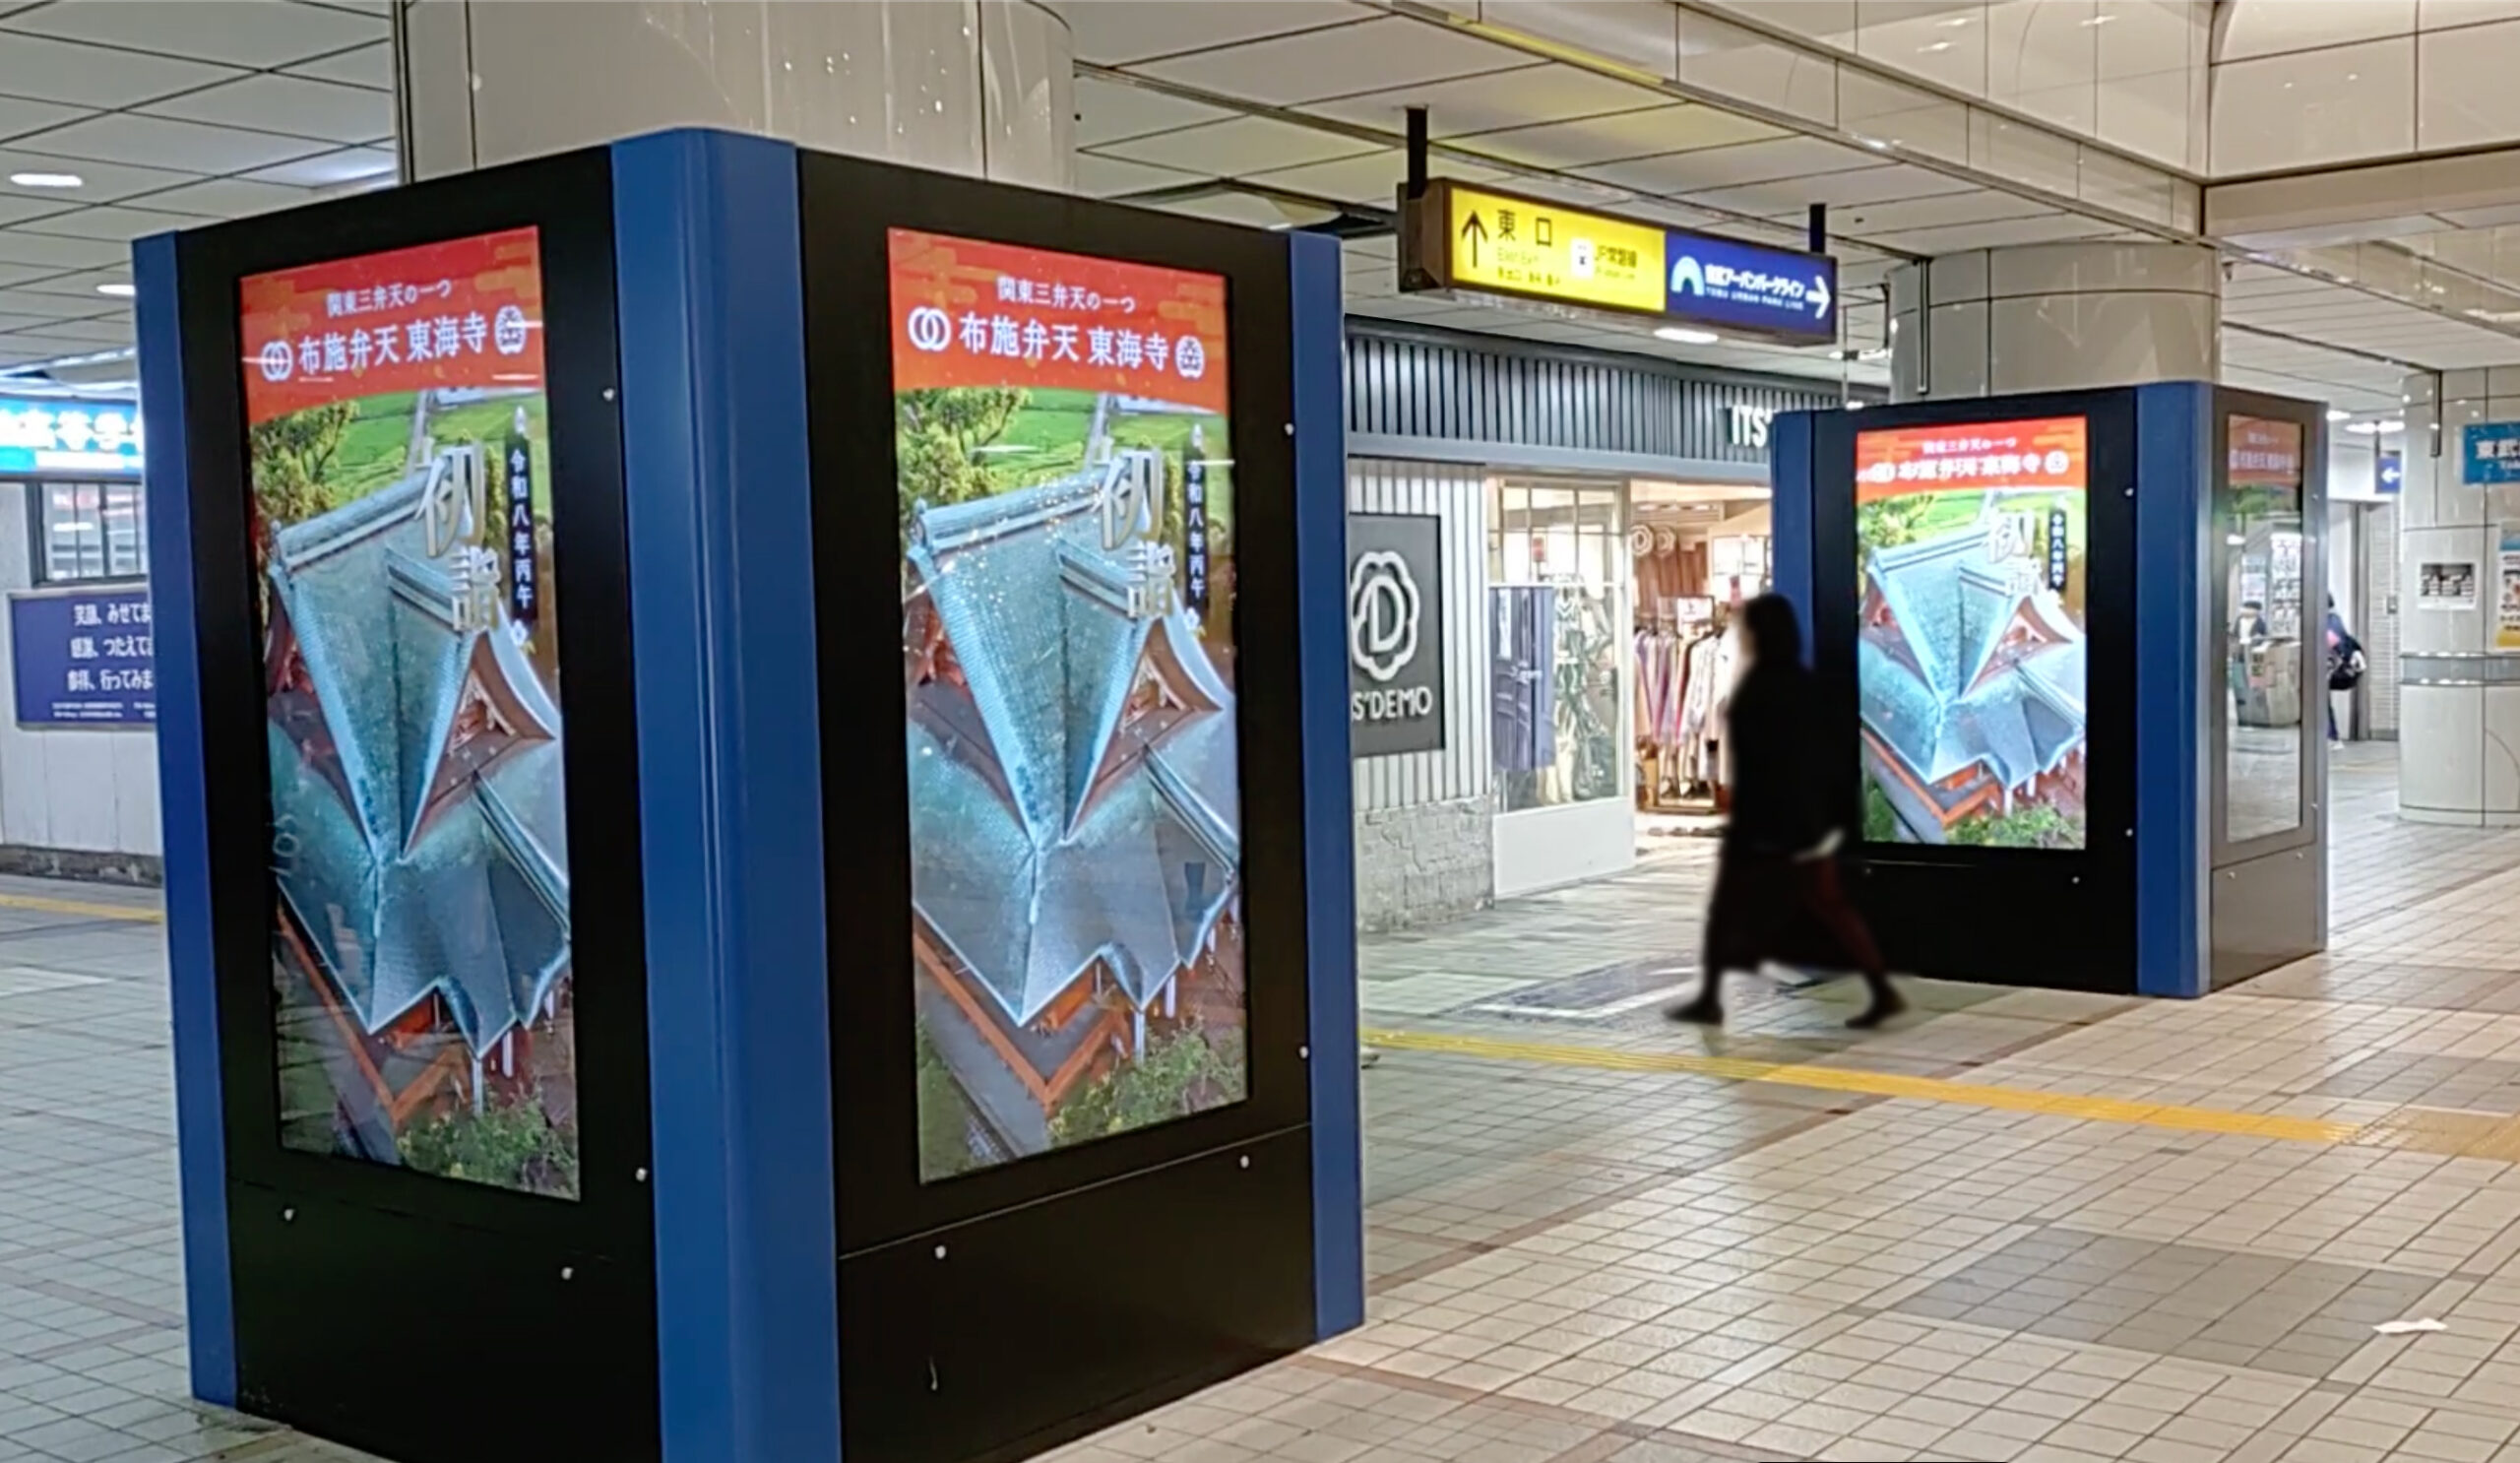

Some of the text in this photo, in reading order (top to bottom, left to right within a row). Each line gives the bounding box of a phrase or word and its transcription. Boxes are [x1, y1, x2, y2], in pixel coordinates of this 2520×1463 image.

[1496, 209, 1552, 247] 東口
[326, 278, 452, 318] 関東三弁天の一つ
[997, 275, 1136, 314] 関東三弁天の一つ
[297, 311, 488, 376] 布施弁天 東海寺
[959, 312, 1169, 371] 布施弁天 東海寺
[413, 436, 502, 632] 初詣
[510, 447, 534, 609] 令和八年丙午
[1093, 436, 1177, 619] 初詣
